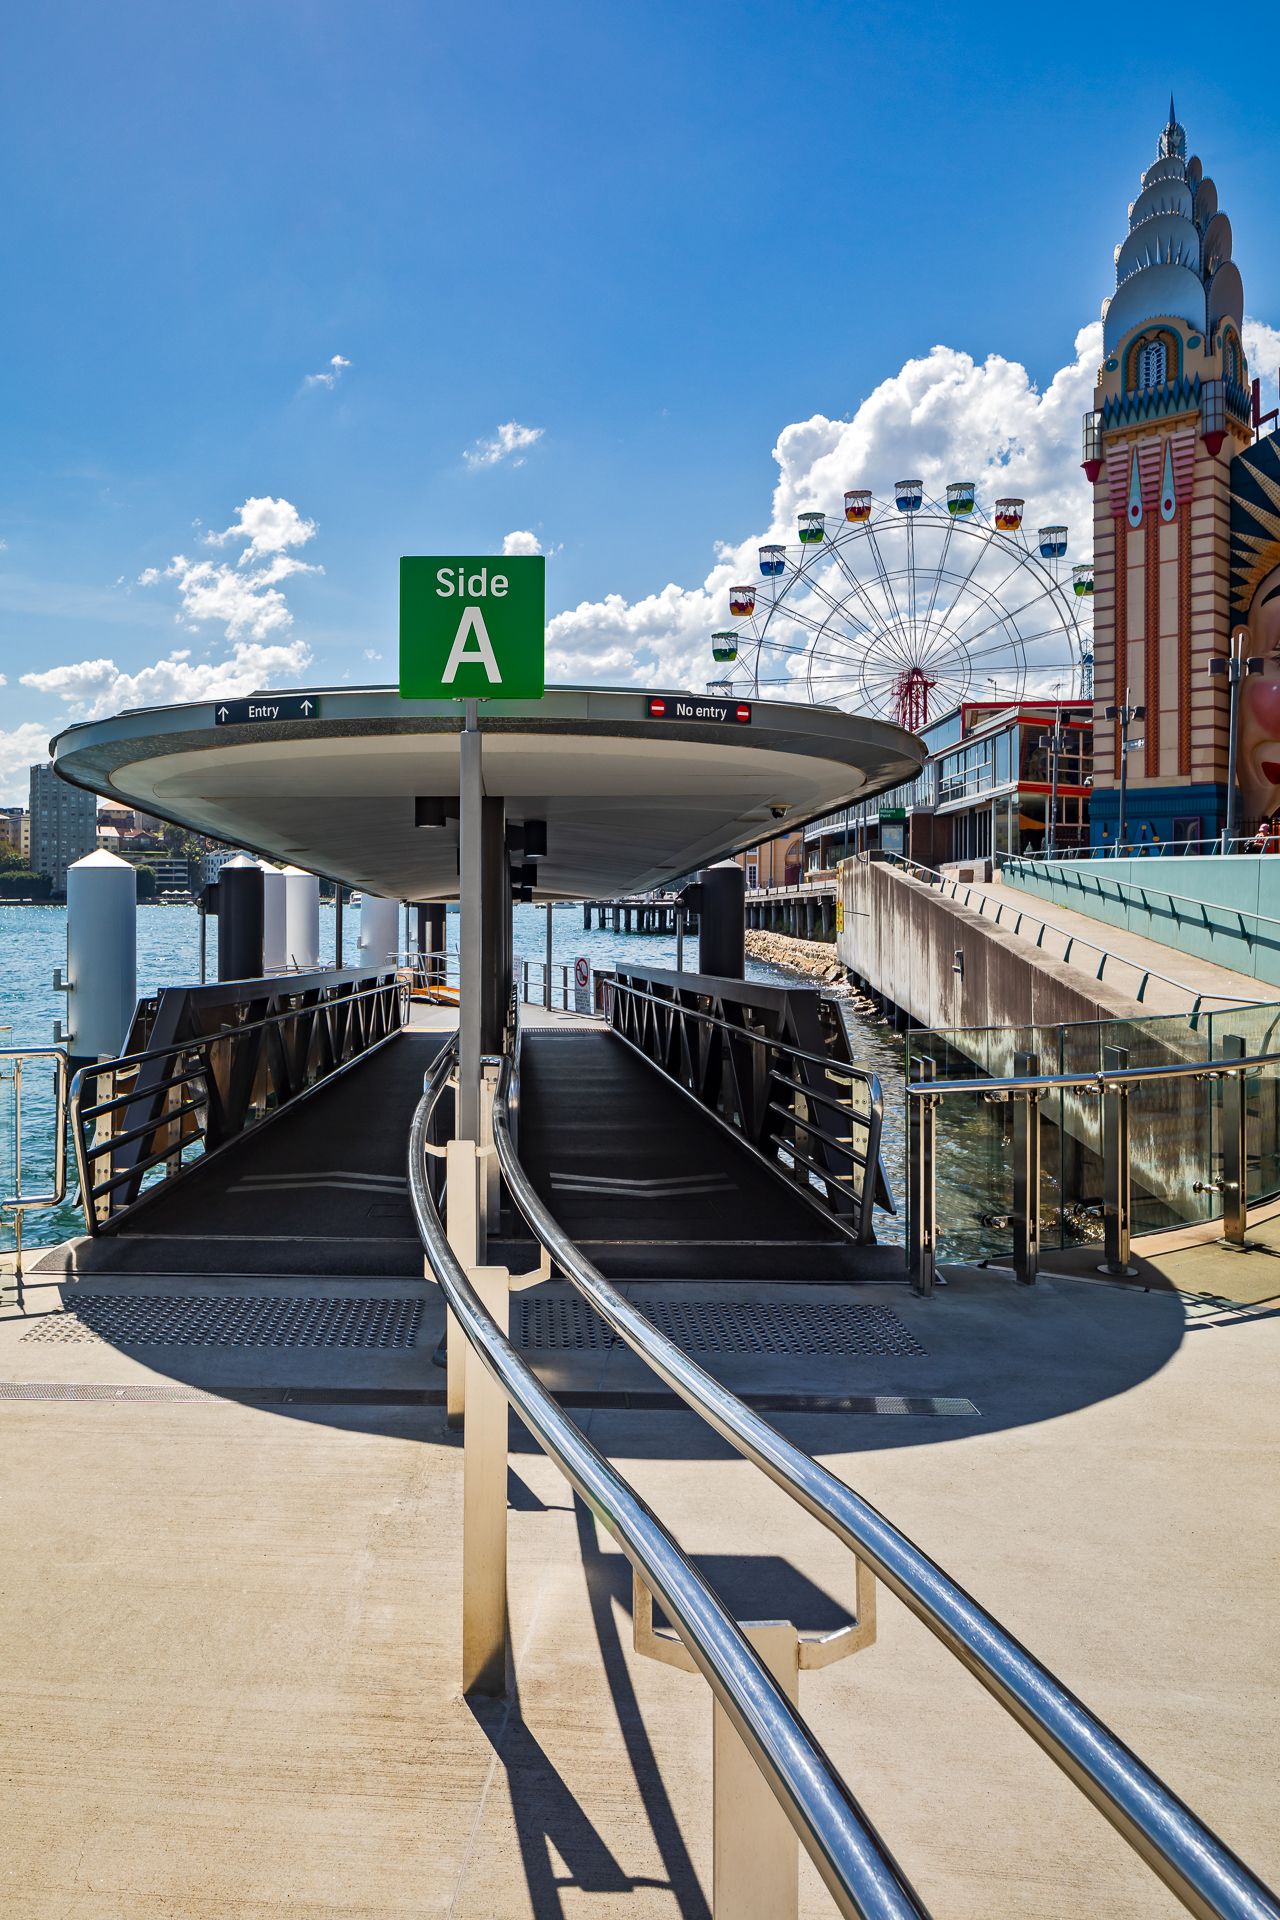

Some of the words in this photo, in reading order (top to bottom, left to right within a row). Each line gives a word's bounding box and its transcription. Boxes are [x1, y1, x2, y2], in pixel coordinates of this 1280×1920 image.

[436, 568, 508, 597] Side
[442, 607, 502, 683] A
[248, 705, 279, 719] Entry
[676, 703, 693, 717] No
[695, 705, 727, 721] entry
